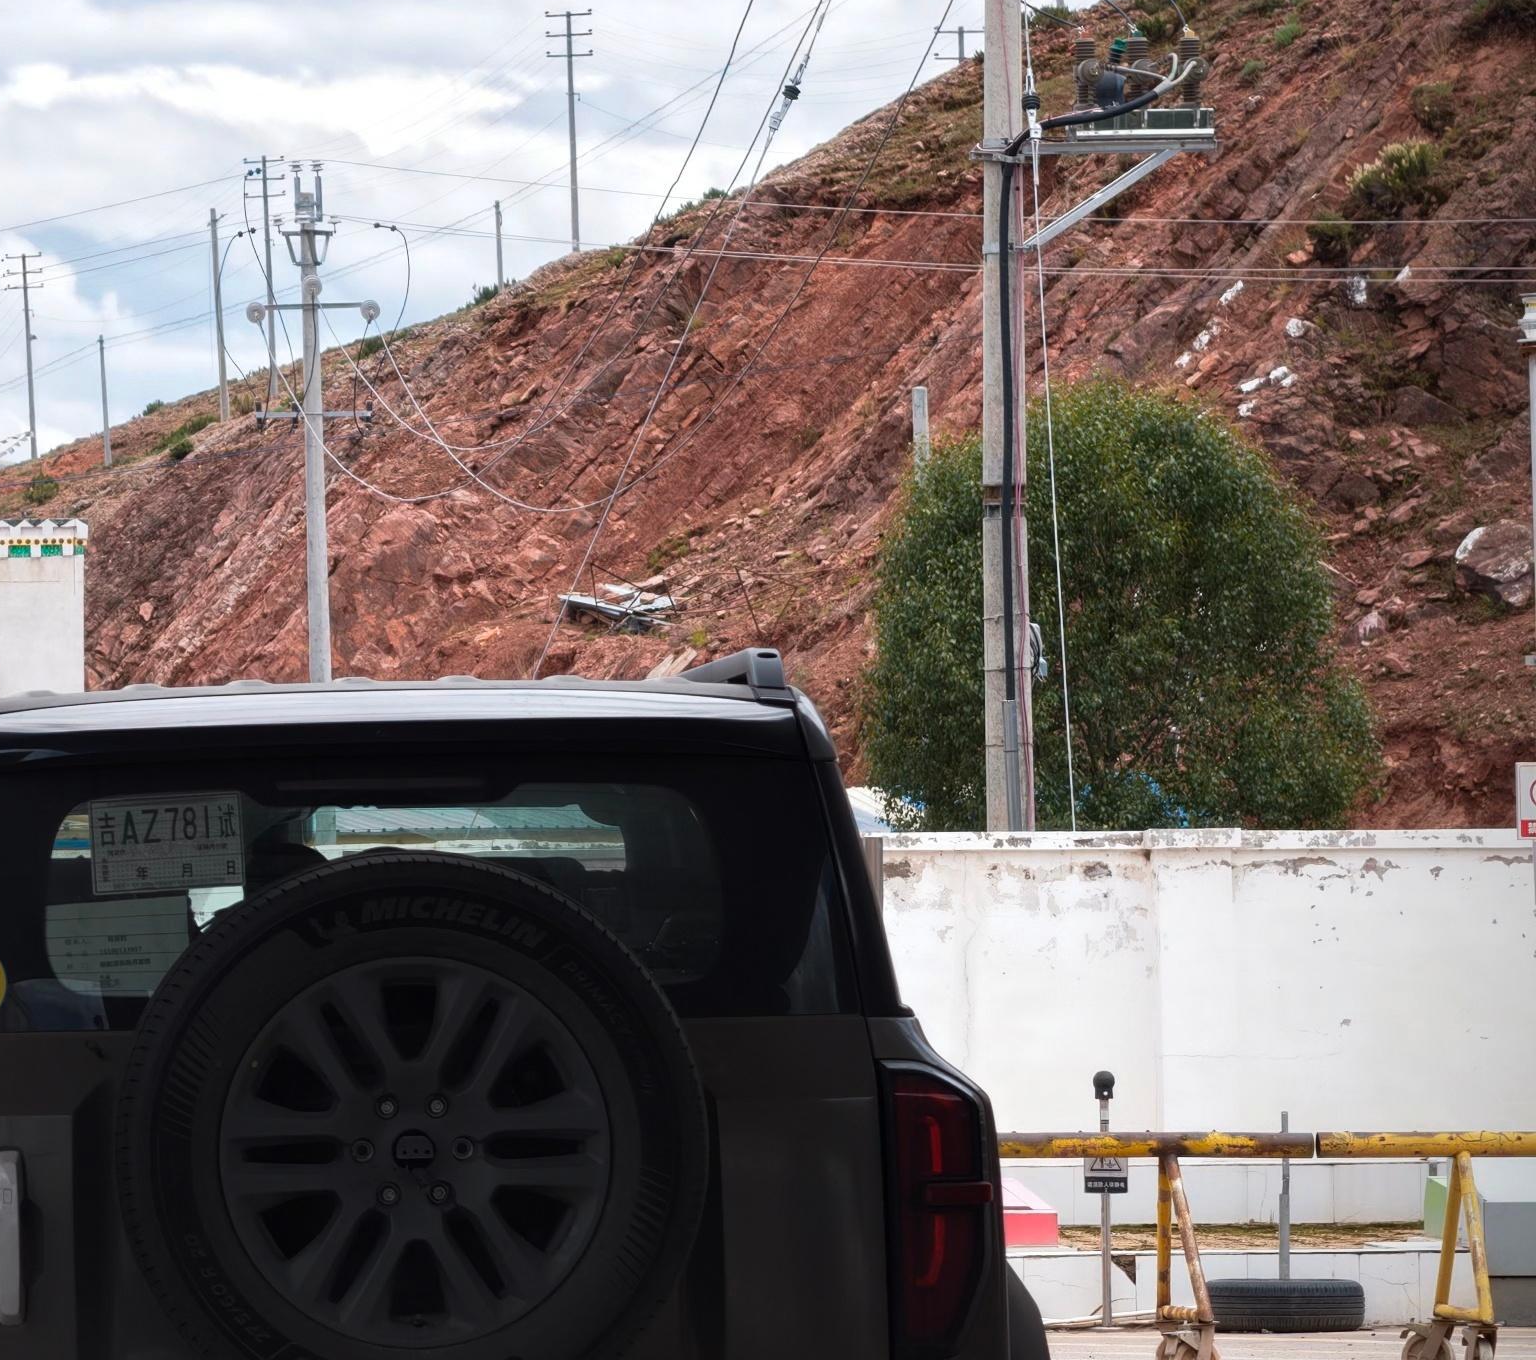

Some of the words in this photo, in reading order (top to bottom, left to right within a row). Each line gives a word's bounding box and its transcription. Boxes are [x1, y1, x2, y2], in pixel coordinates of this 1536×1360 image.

[97, 803, 236, 847] 吉AZ781试
[181, 863, 194, 879] 月
[225, 860, 237, 876] 日
[360, 894, 549, 949] MICHELIN
